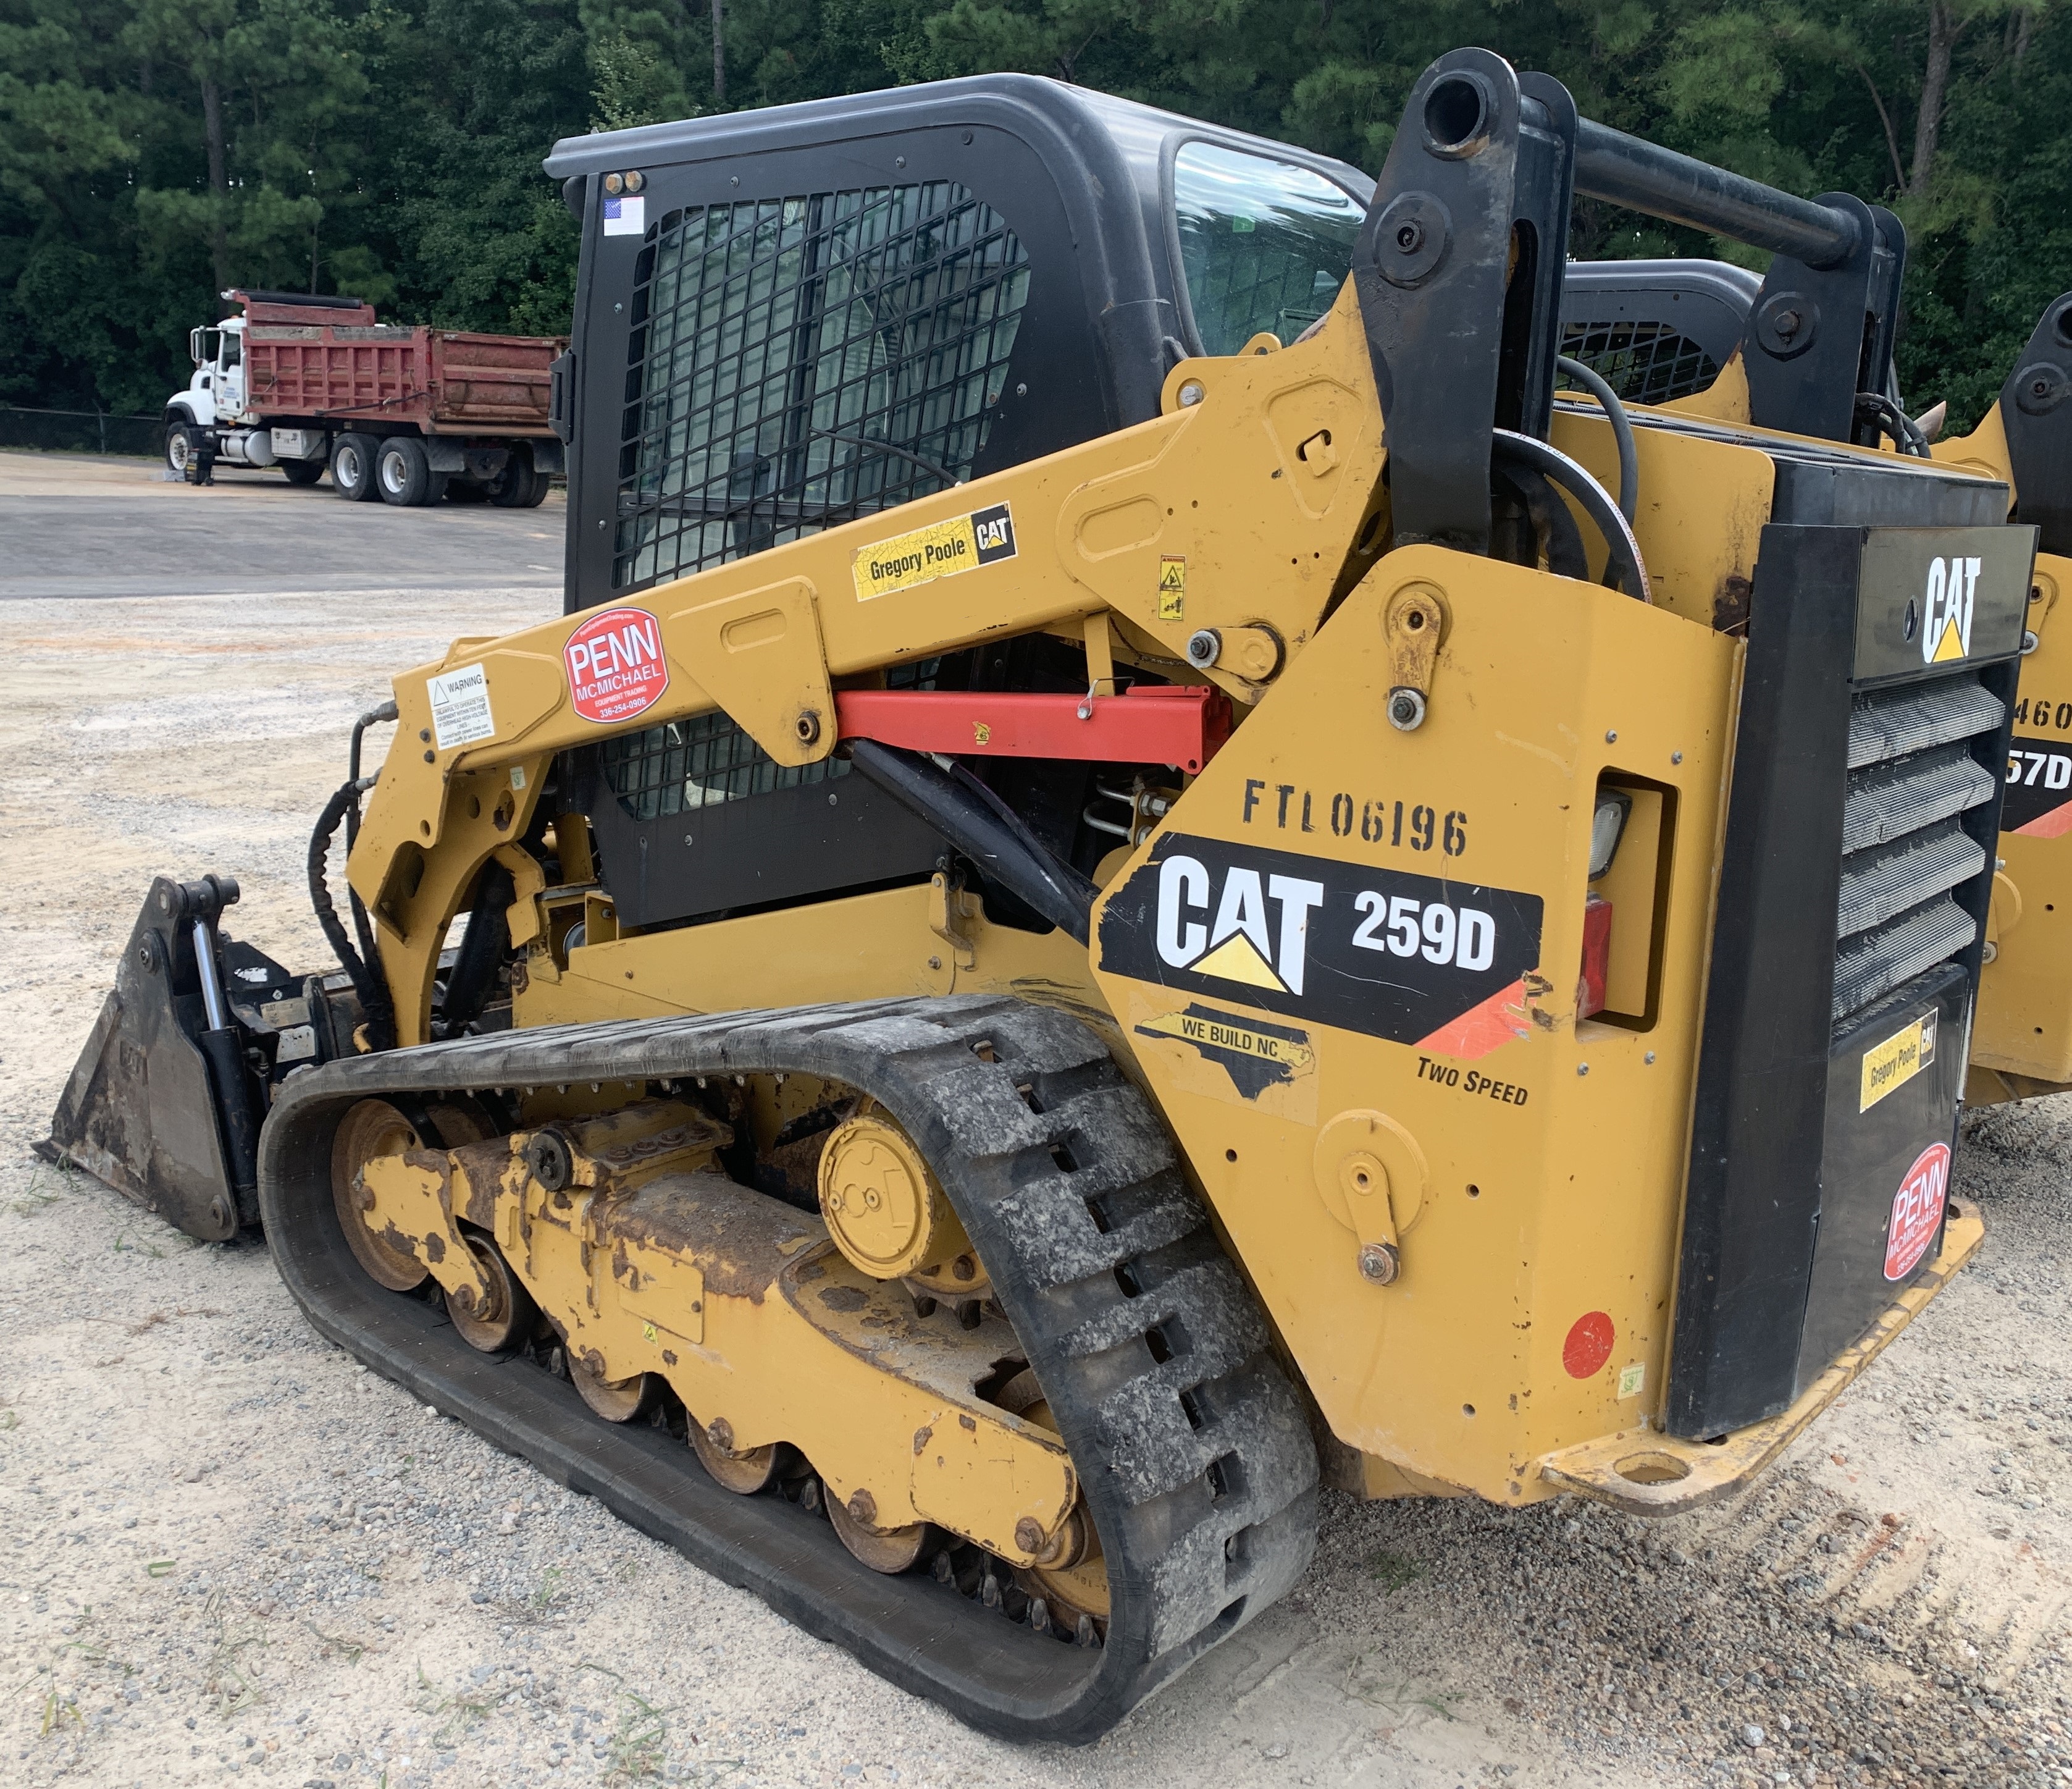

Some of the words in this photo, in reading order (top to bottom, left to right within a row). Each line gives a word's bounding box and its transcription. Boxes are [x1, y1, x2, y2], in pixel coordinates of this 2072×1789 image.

[870, 552, 921, 581] Gregory
[925, 537, 965, 565] Poole
[976, 517, 1008, 550] CAT
[1923, 557, 1981, 663] CAT
[569, 618, 657, 686] PENN
[447, 674, 482, 692] WARNING
[576, 663, 662, 702] MCMICHAEL
[594, 692, 624, 707] EQUIPMENT
[624, 685, 647, 697] TRADING
[435, 707, 455, 716] UNLAWFUL
[460, 699, 477, 709] OPERATE
[436, 712, 456, 723] EQUIPMENT
[442, 717, 462, 727] OVERHEAD
[599, 696, 647, 718] 336-254-0906
[2015, 698, 2072, 730] 460
[441, 732, 455, 740] Contact
[461, 728, 472, 736] power
[1156, 854, 1323, 996] CAT
[1351, 890, 1496, 972] 259D
[1181, 1018, 1207, 1039] WE
[1209, 1024, 1252, 1051] BUILD
[1257, 1035, 1279, 1058] NC
[1871, 1056, 1897, 1088] Gregory
[1897, 1042, 1916, 1069] Poole
[1921, 1024, 1935, 1054] CAT
[1892, 1153, 1947, 1240] PENN
[1889, 1202, 1939, 1261] MCMICHAEL
